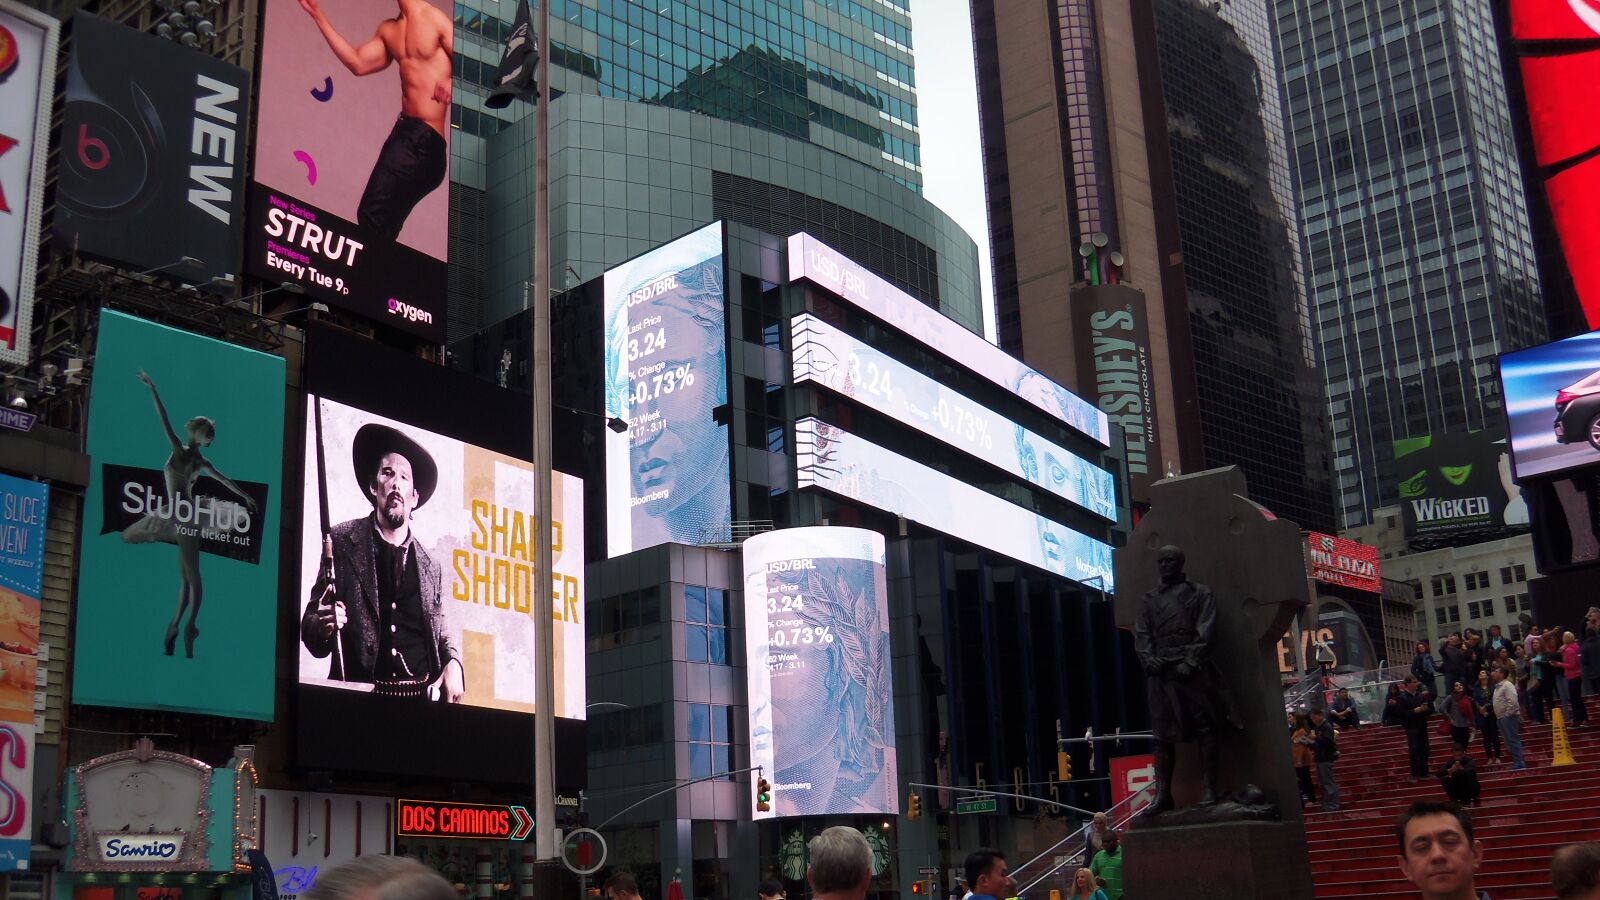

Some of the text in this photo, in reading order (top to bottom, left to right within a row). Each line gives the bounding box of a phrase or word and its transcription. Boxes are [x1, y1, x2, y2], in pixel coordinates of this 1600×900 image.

[187, 73, 240, 226] NEW
[269, 195, 316, 222] New Series
[264, 207, 364, 267] STRUT
[267, 239, 311, 265] Premieres
[267, 251, 350, 296] Every Tue 9p
[810, 248, 870, 300] USD/BRL
[627, 275, 679, 308] USD/BRL
[628, 314, 662, 335] Last Price
[628, 327, 667, 362] 3.24
[638, 361, 666, 378] Change
[628, 363, 695, 405] +0.73%
[1138, 345, 1155, 443] MILK CHOCOLATE
[629, 409, 661, 428] 52 Week
[651, 418, 667, 432] 3.11
[931, 398, 993, 451] +0.73%
[4, 493, 40, 525] SLICE
[121, 481, 251, 533] StubHub
[630, 488, 670, 508] Bloomberg
[175, 523, 251, 547] Your ticket out
[471, 499, 563, 563] SHAP
[766, 558, 817, 573] USD/BRL
[452, 548, 580, 625] SHOOER
[780, 583, 799, 592] Price
[768, 594, 804, 614] 3.24
[776, 618, 804, 628] Change
[769, 626, 834, 647] +0.73%
[778, 653, 799, 662] Week
[788, 660, 805, 670] 3.11
[774, 782, 812, 791] Bloomberg
[402, 805, 510, 835] DOS CAMINOS
[106, 838, 177, 858] Sanrio
